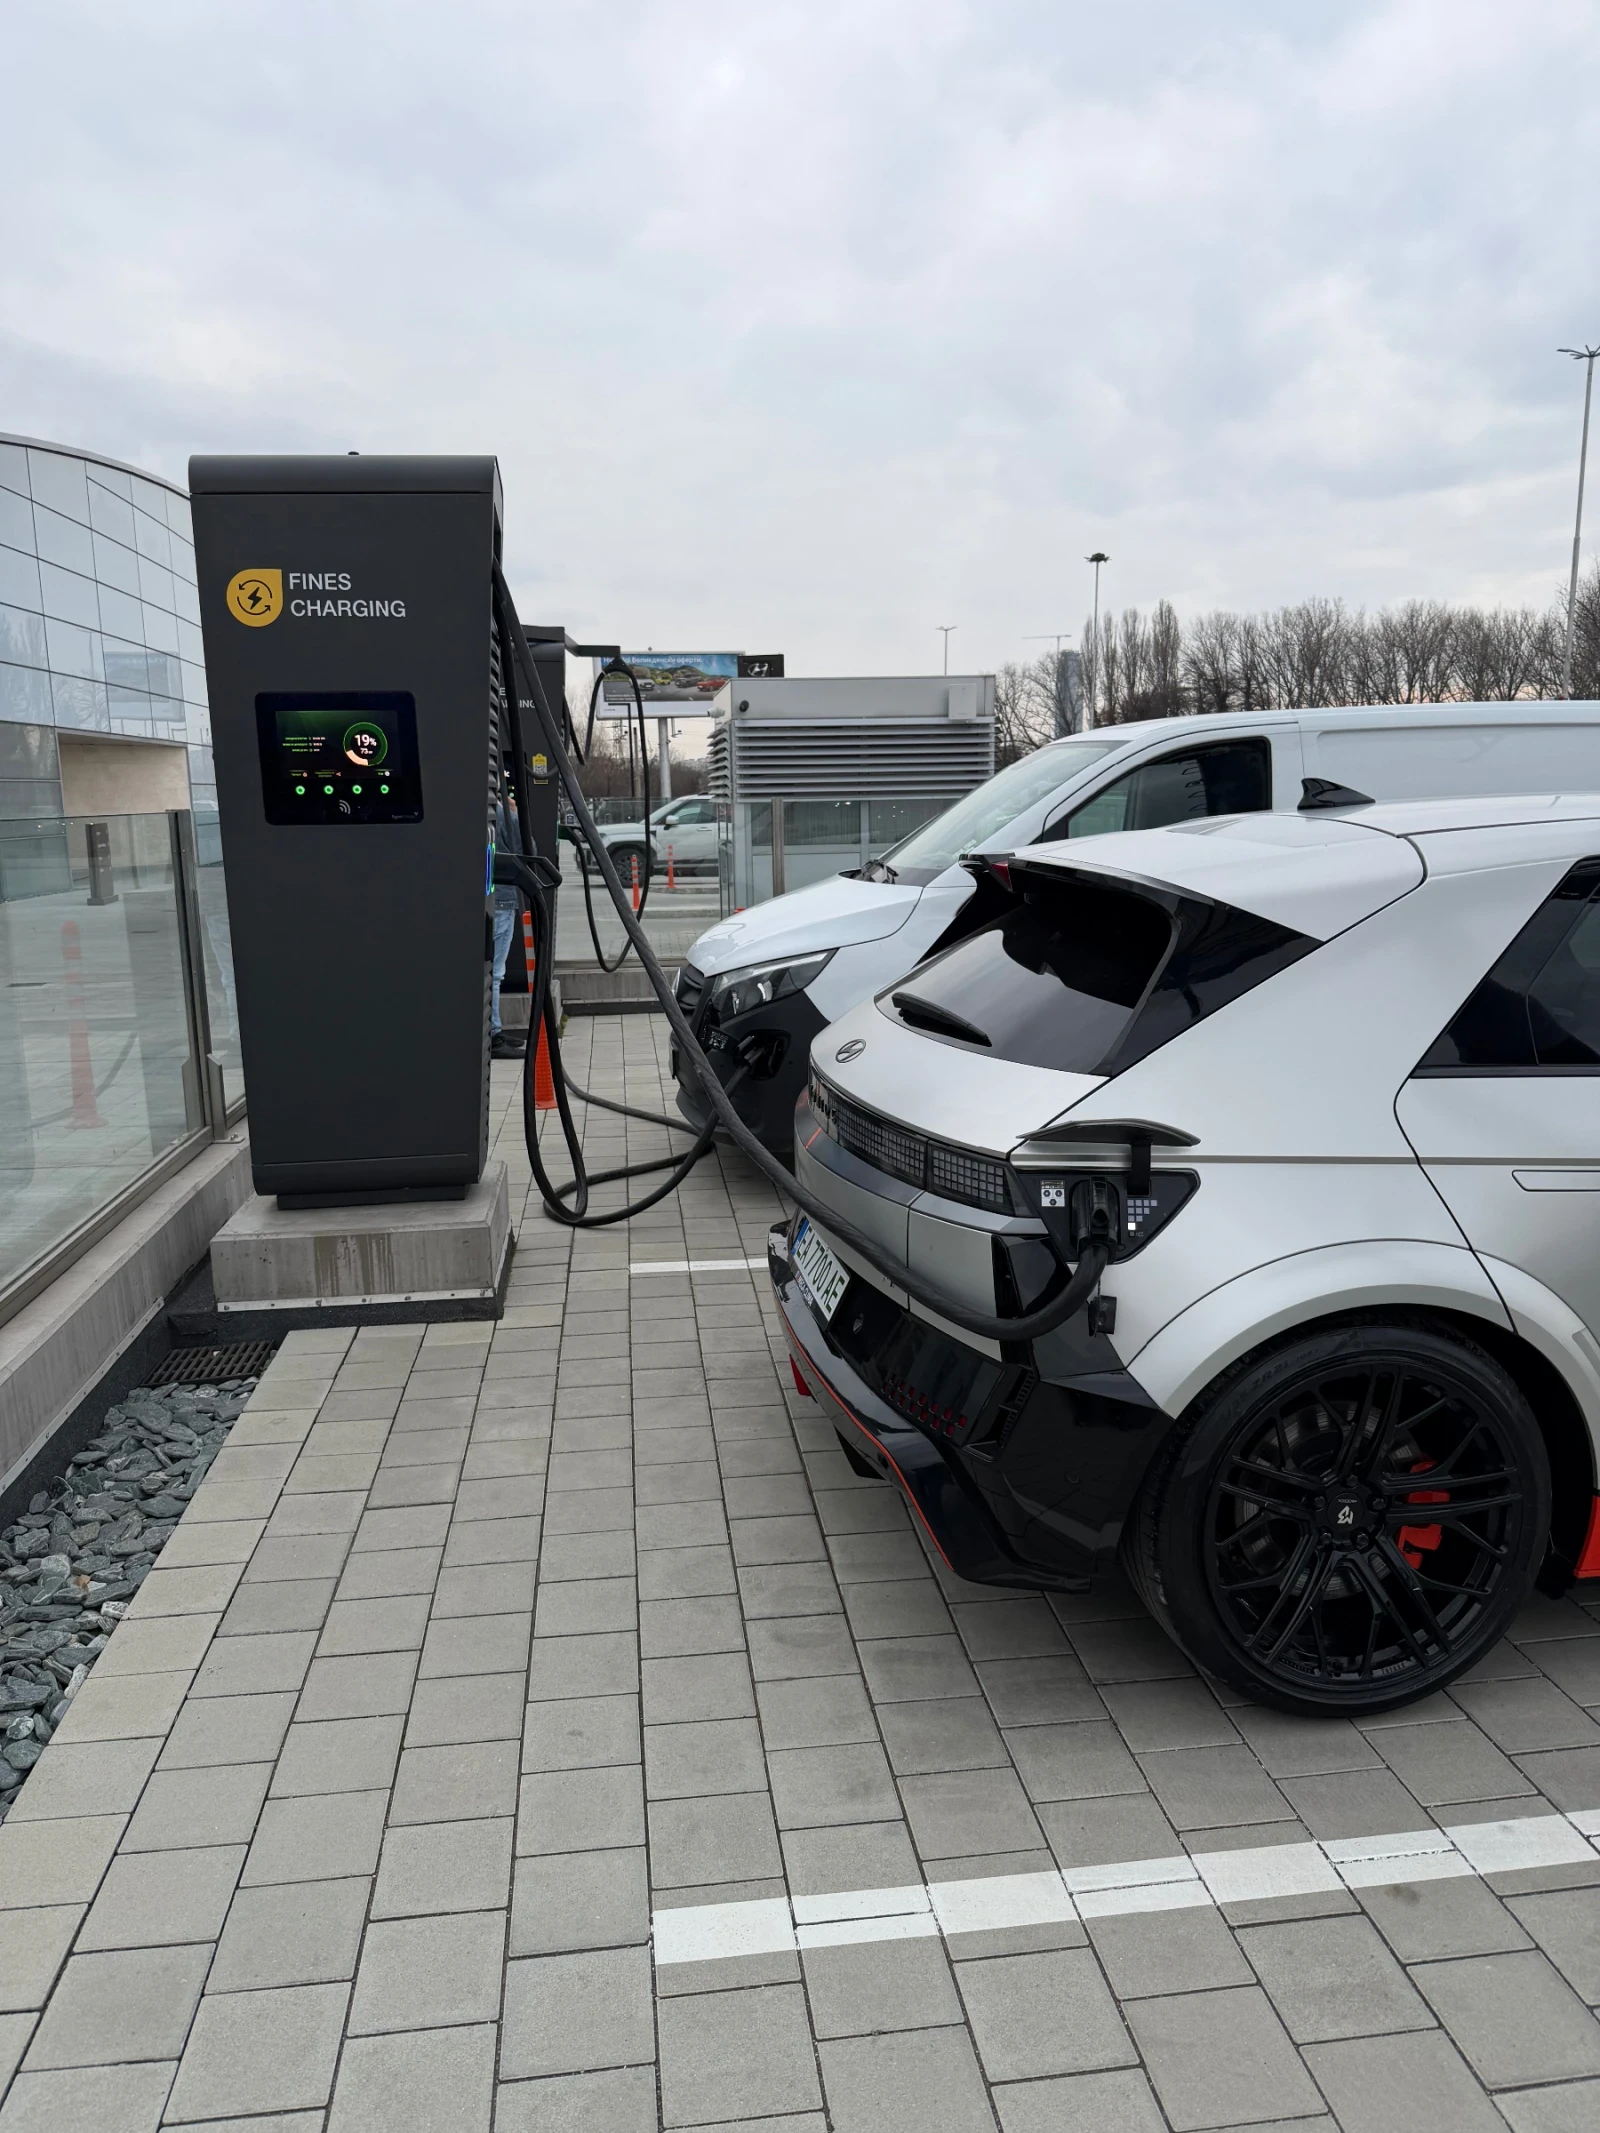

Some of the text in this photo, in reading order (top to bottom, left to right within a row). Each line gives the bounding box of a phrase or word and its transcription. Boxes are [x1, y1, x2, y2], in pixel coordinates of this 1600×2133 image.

[288, 573, 352, 591] FINES
[290, 600, 406, 618] CHARGING
[354, 734, 377, 747] 19%
